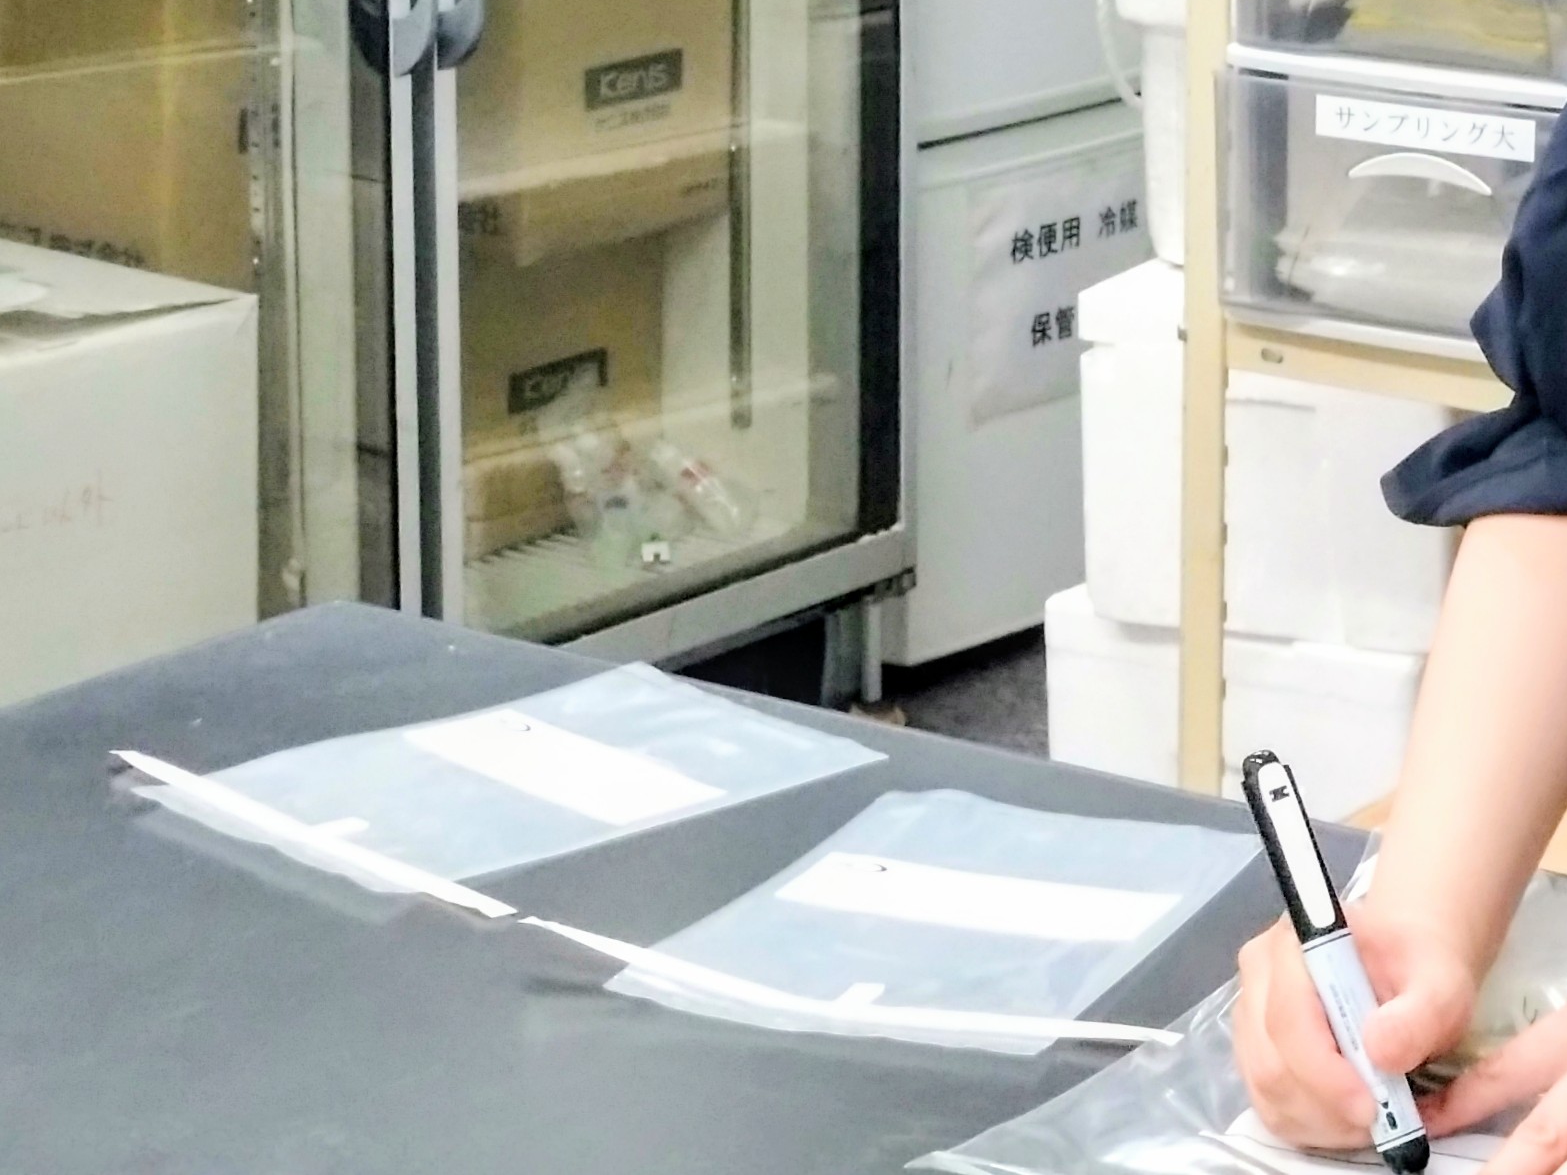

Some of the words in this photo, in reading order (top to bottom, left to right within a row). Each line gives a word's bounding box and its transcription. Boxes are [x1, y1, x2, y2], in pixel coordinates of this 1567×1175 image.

[1335, 106, 1516, 152] サンプリング大
[1010, 216, 1081, 265] 検便用
[1096, 198, 1139, 240] 冷媒
[1030, 305, 1076, 348] 保管
